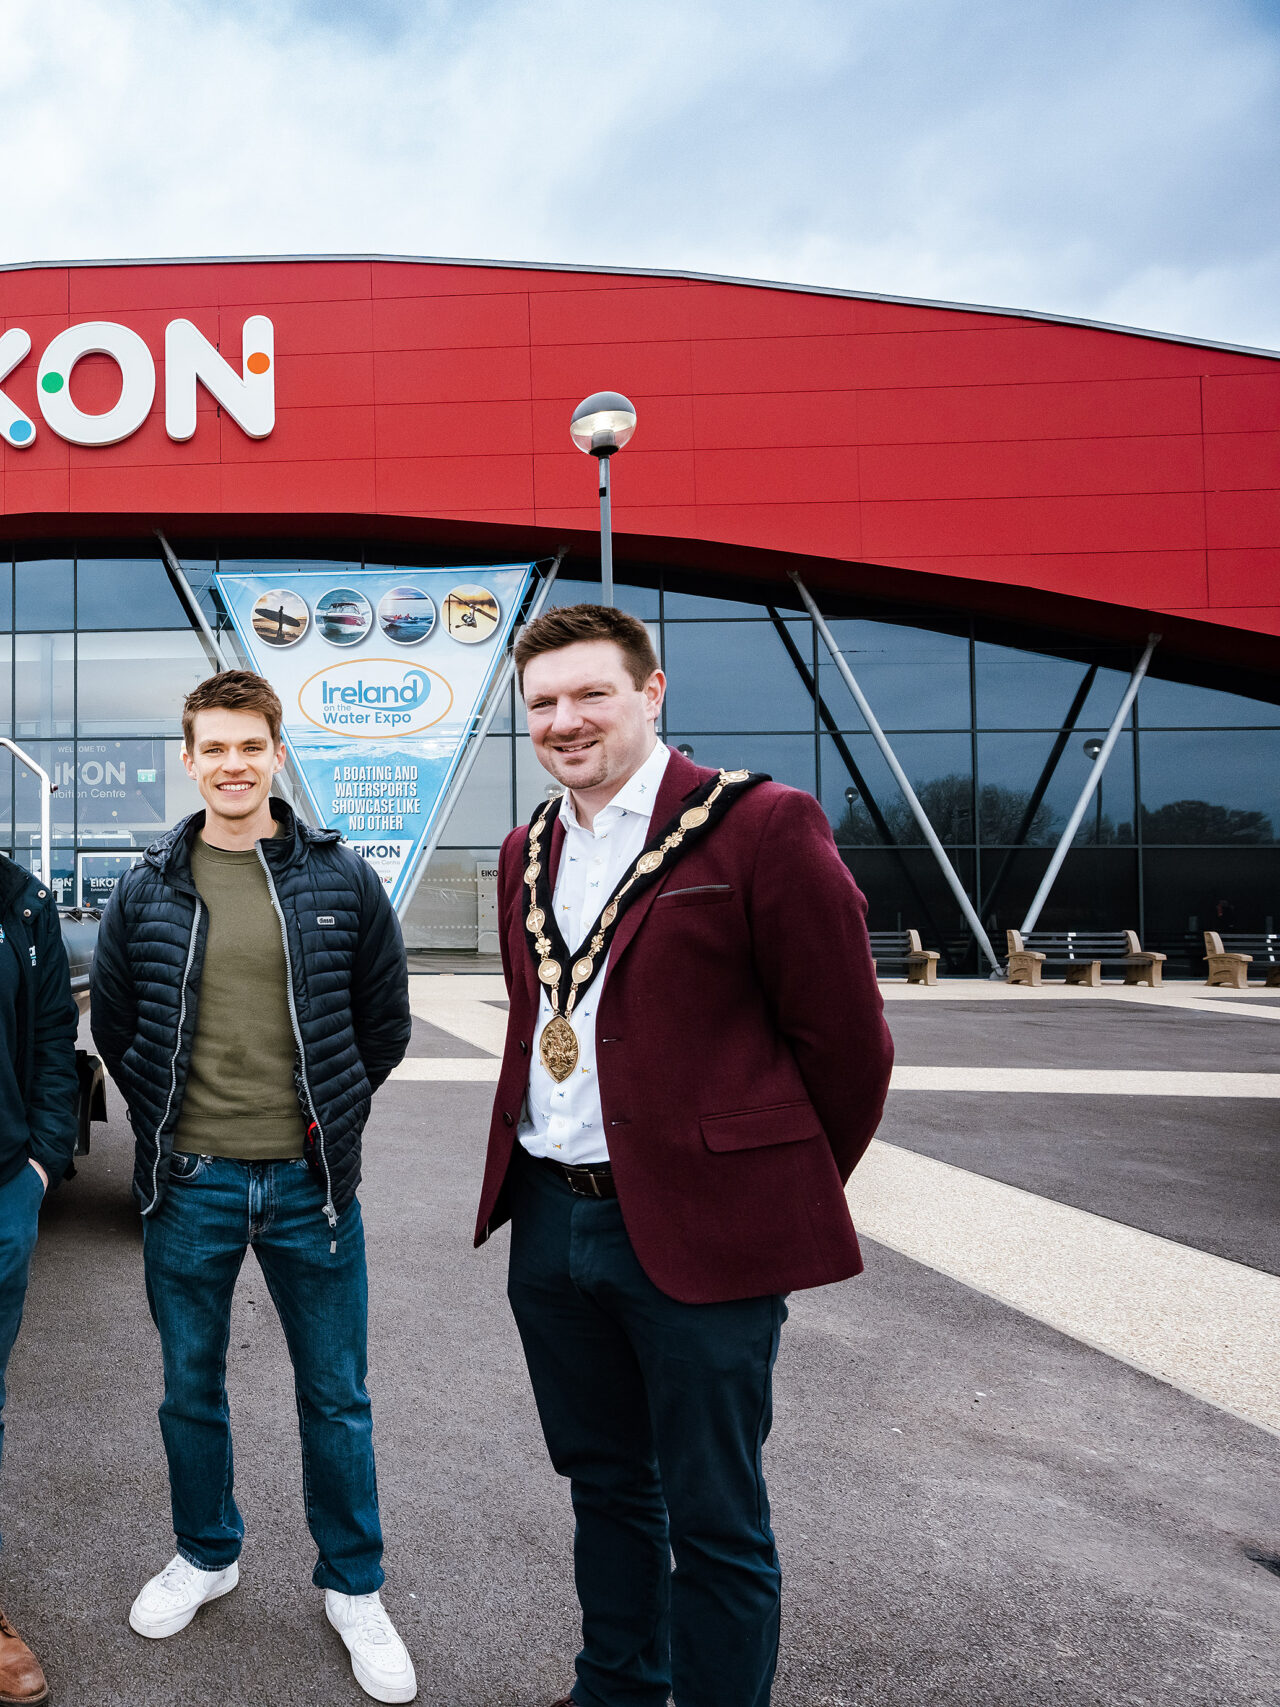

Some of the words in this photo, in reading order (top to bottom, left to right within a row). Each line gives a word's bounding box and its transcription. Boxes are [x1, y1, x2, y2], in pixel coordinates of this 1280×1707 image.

[322, 679, 418, 704] Ireland
[336, 704, 352, 712] the
[323, 712, 371, 724] Water
[375, 711, 412, 727] Expo
[58, 745, 95, 753] WELOME
[54, 760, 126, 785] IKON
[333, 766, 341, 781] A
[343, 765, 392, 781] BOATING
[394, 765, 419, 781] AND
[90, 788, 126, 798] Centre
[335, 782, 417, 798] WATERSPORTS
[332, 799, 395, 815] SHOWCASE
[397, 798, 421, 814] LIKE
[349, 815, 365, 831] NO
[367, 815, 404, 831] OTHER
[353, 845, 401, 858] EIKON
[481, 869, 498, 877] EIKO
